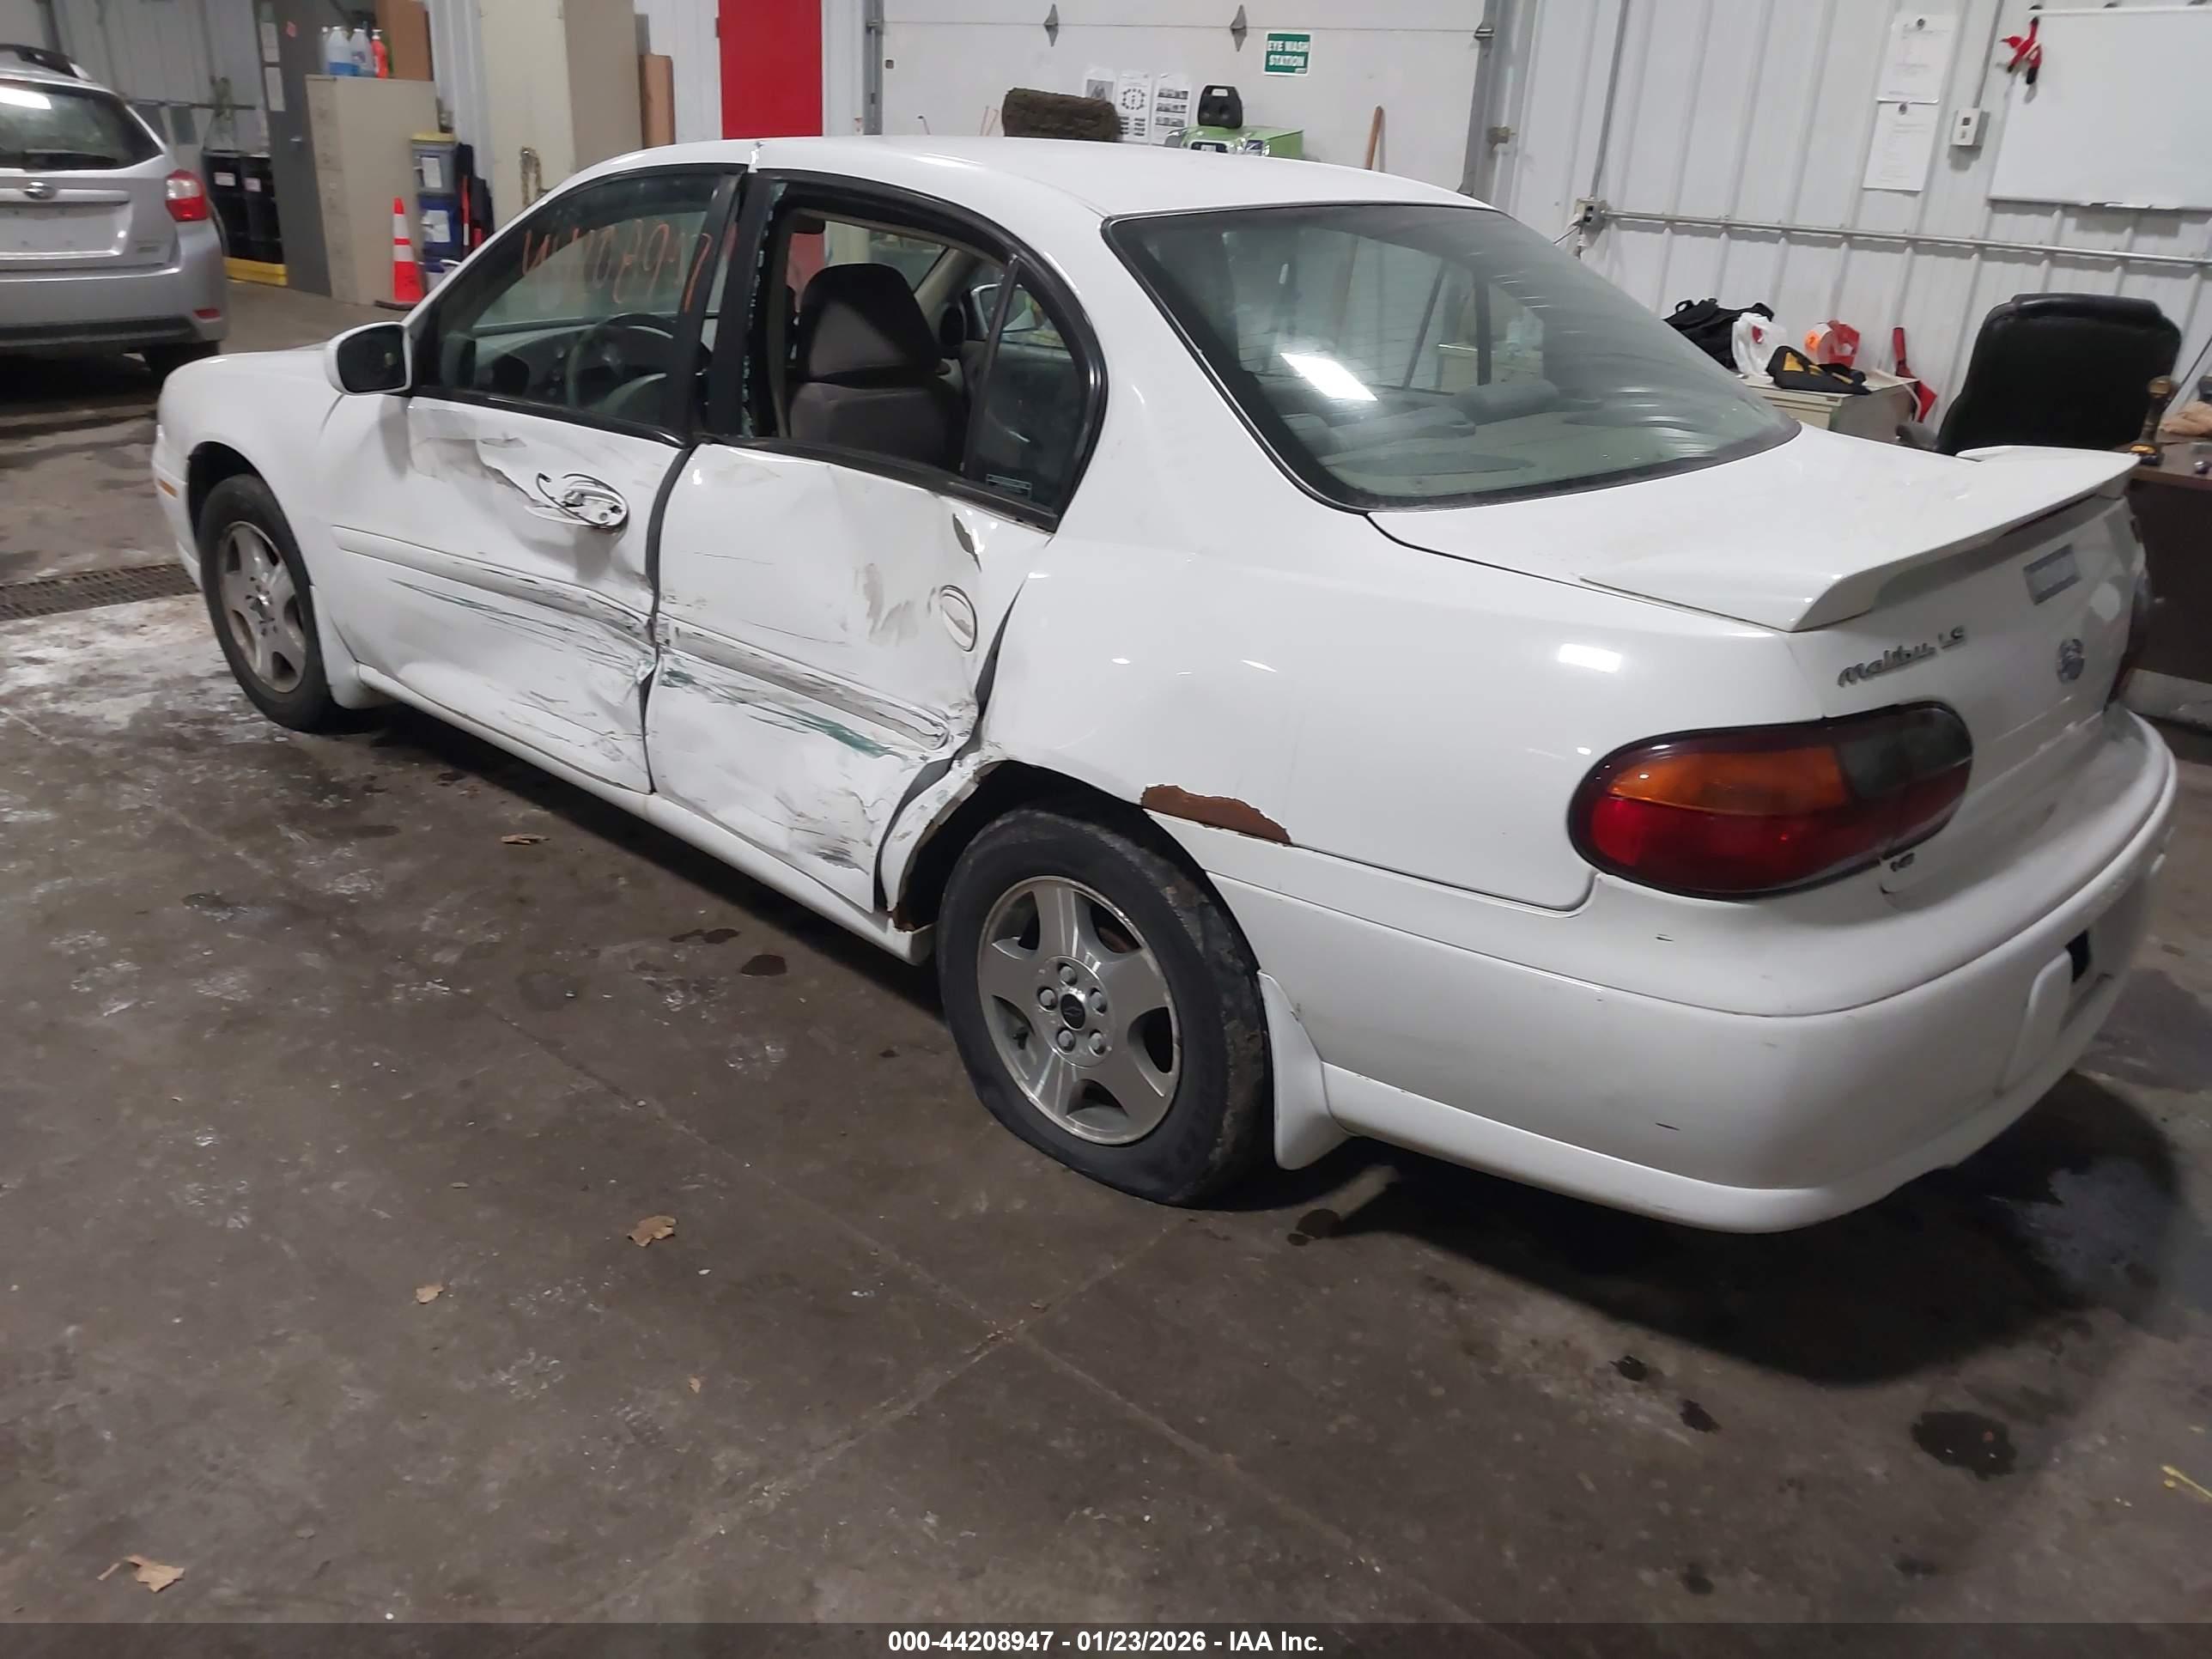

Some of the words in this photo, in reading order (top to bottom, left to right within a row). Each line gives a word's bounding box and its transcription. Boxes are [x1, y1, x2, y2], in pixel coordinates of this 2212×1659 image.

[1267, 40, 1285, 52] EYE
[1268, 55, 1305, 66] STATION
[1938, 626, 1966, 650] LS
